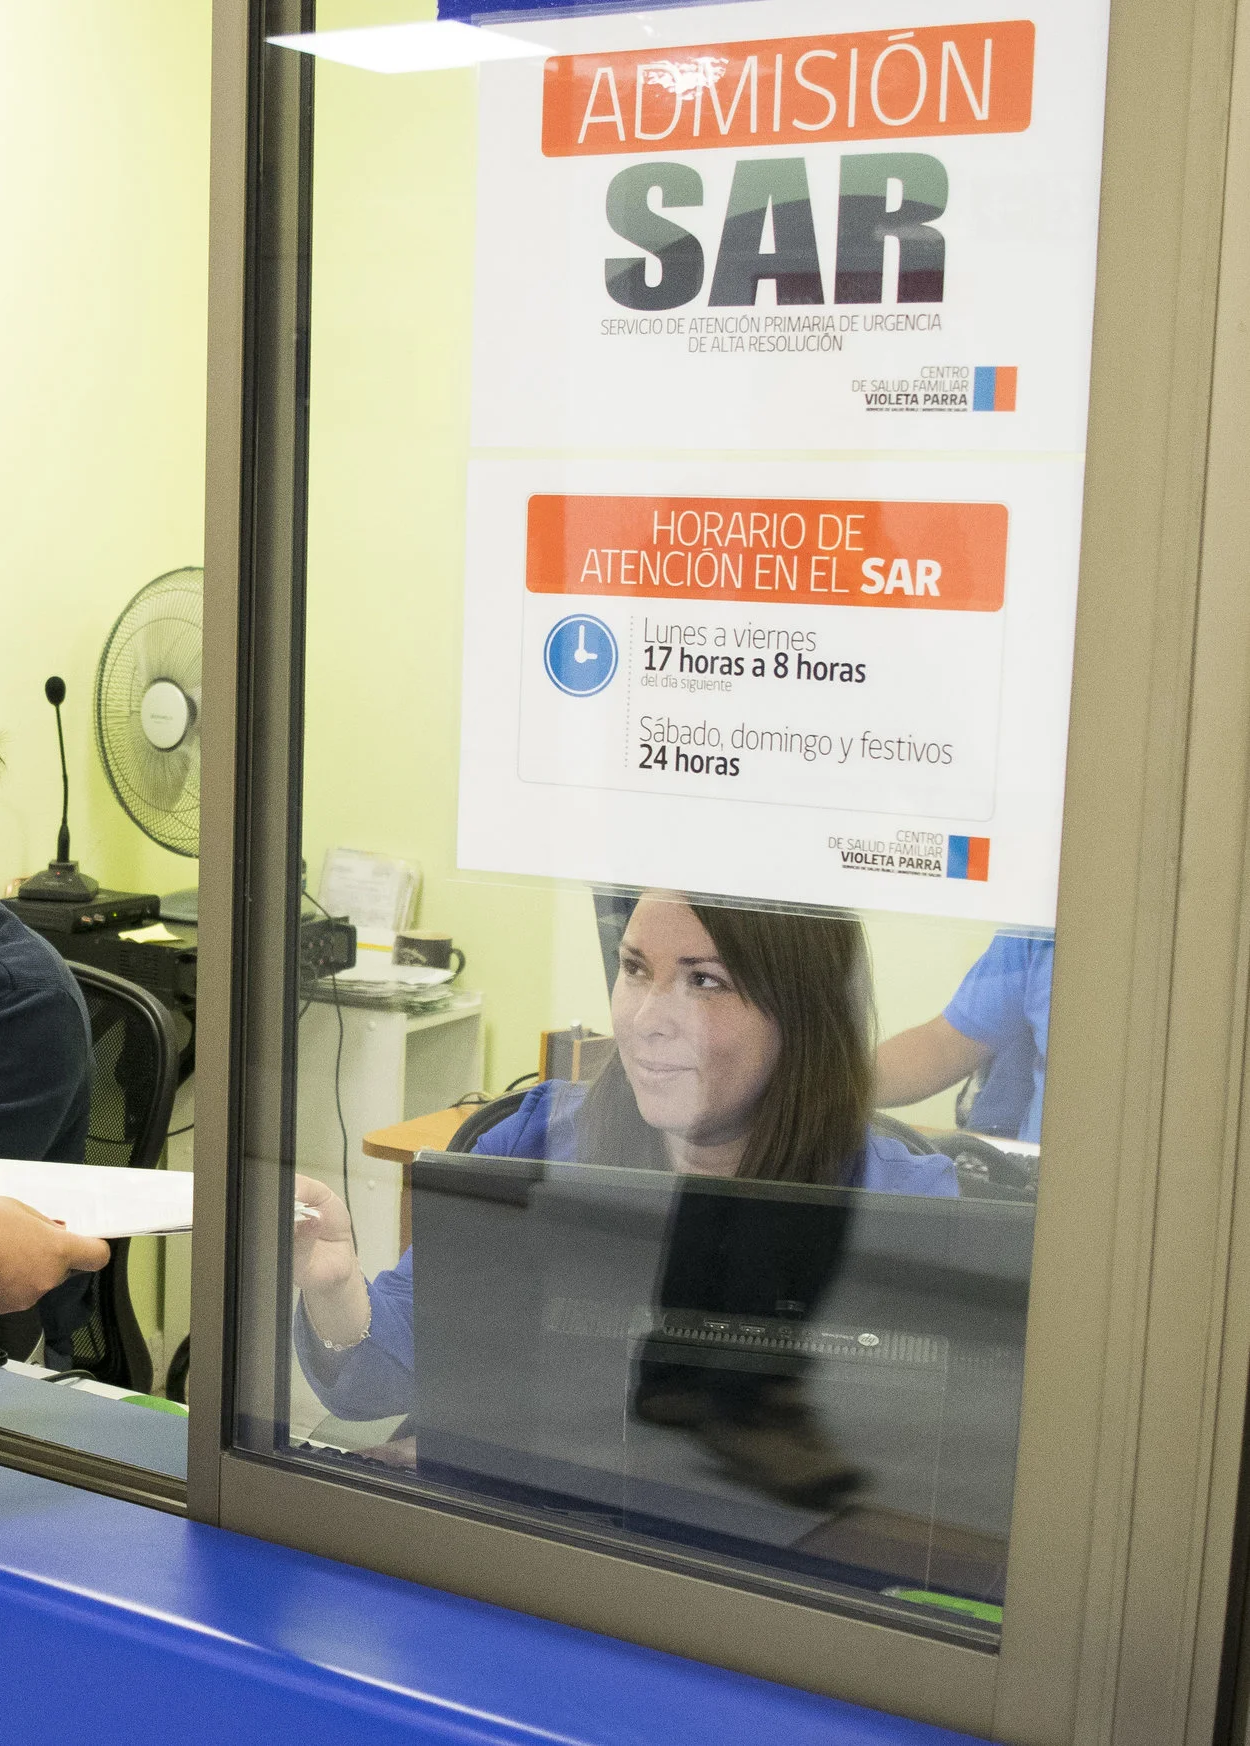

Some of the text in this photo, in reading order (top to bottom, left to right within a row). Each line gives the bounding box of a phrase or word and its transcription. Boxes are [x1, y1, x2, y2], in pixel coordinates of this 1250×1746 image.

[578, 31, 993, 144] ADMISIÓN
[604, 152, 948, 312] SAR
[600, 313, 942, 336] SERVICIO DE ATENCIÓN PRIMARIA DE URGENCIA
[688, 332, 844, 353] DE ALTA RESOLUCIÓN
[921, 366, 970, 379] CENTRO
[851, 380, 970, 392] DE SALUD FAMILIAR
[865, 393, 968, 406] VIOLETA PARRA
[653, 510, 865, 551] HORARIO DE
[580, 547, 942, 597] ATENCIÓN EN EL SAR
[644, 616, 817, 652] Lunes a viernes
[644, 645, 866, 684] 17 horas a 8 horas
[640, 673, 732, 693] del día siguiente
[639, 715, 953, 765] Sábado, domingo y festivos
[638, 743, 740, 777] 24 horas
[828, 837, 943, 858] DE SALUD FAMILIAR
[896, 830, 943, 845] CENTRO
[841, 851, 895, 867] VIOLETA
[899, 856, 942, 871] PARRA
